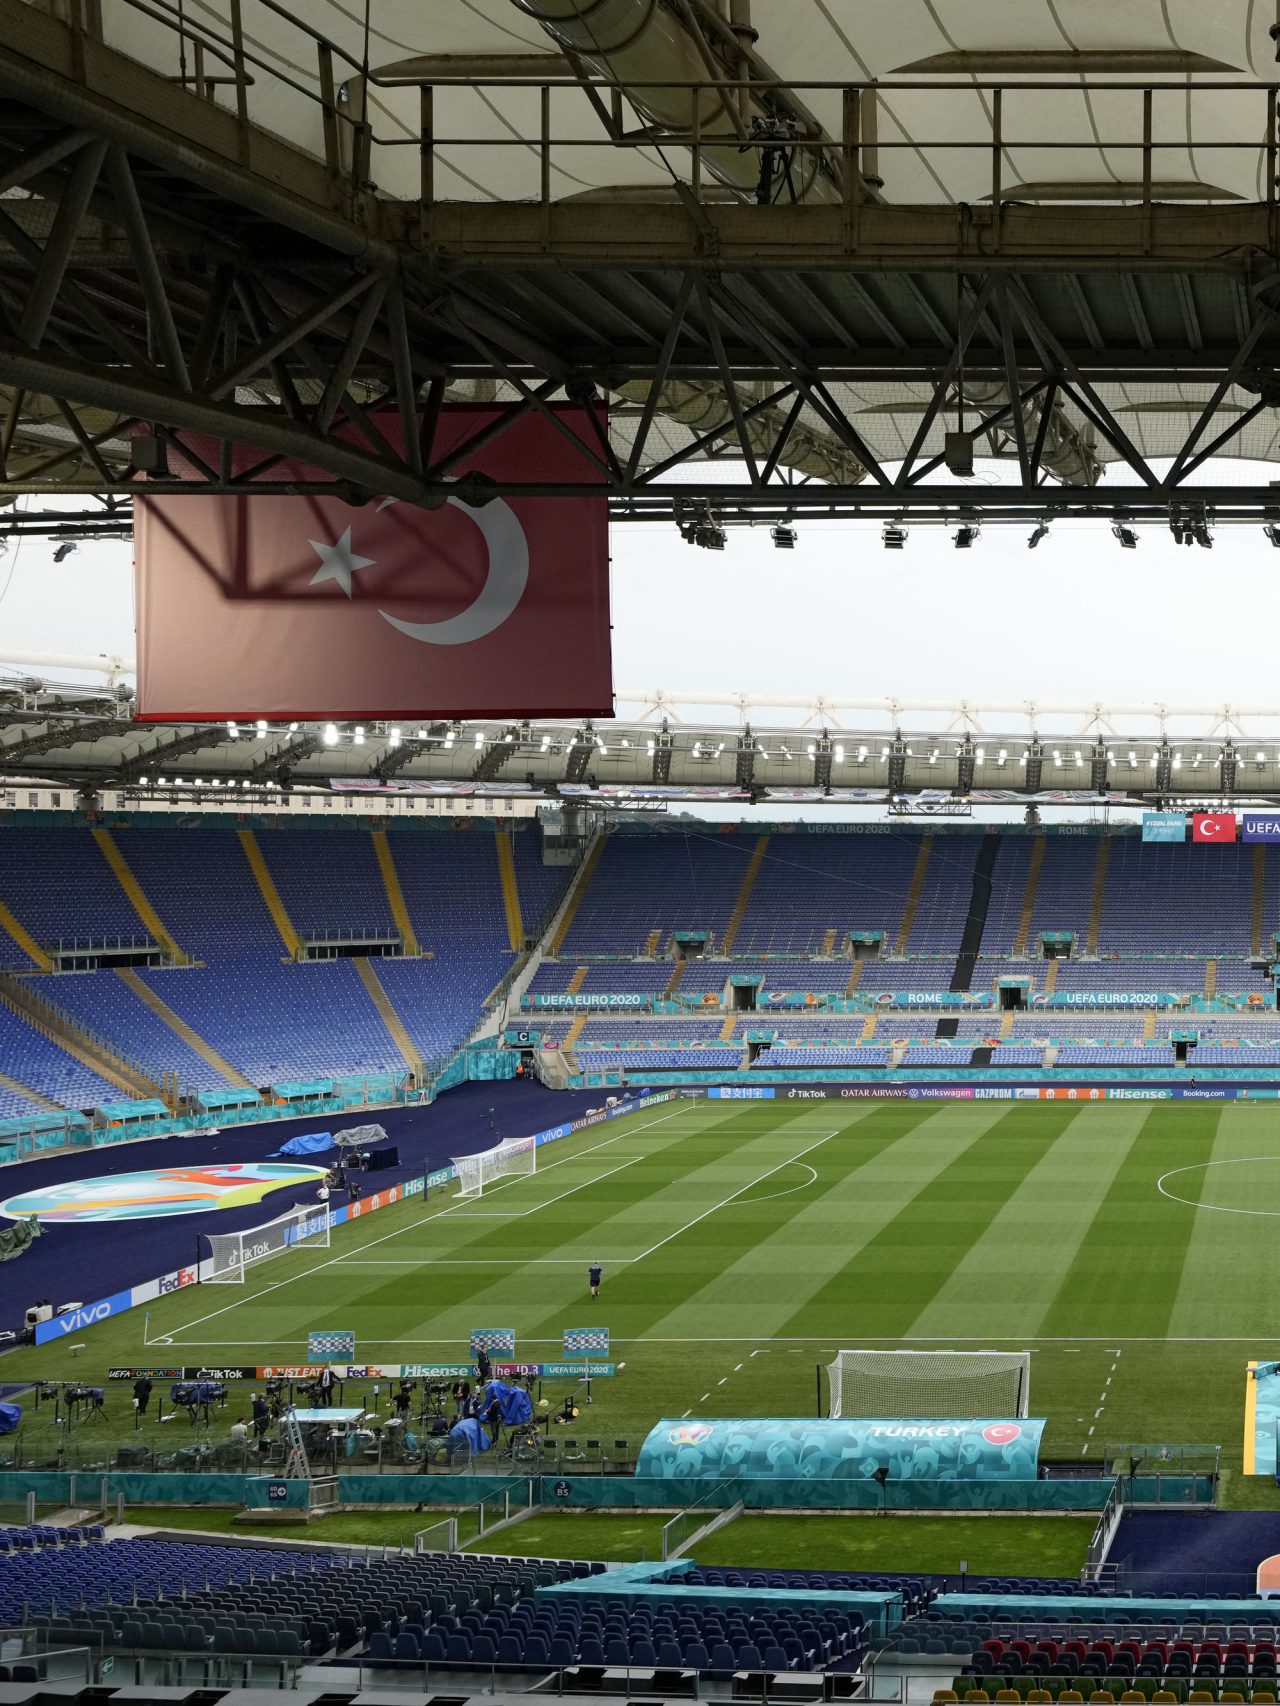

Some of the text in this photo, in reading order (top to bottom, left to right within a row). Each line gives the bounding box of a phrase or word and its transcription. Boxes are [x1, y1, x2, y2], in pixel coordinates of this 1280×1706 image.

[807, 825, 890, 834] UEFA EURO 2020
[1058, 826, 1088, 835] ROME
[541, 995, 640, 1005] UEFA EURO 2020
[908, 993, 942, 1003] ROME
[1066, 993, 1158, 1003] UEFA EURO 2020
[519, 1032, 528, 1041] C
[798, 1090, 826, 1098] TikTok
[841, 1089, 907, 1098] QATAR AIRWAYS
[921, 1088, 971, 1098] Volkswagen
[975, 1089, 1012, 1098] GAZPROM
[1110, 1089, 1166, 1099] Hisense
[1183, 1090, 1225, 1099] Booking.com
[639, 1093, 669, 1108] Heineken
[541, 1129, 563, 1143] vivo
[158, 1269, 195, 1294] FedEx
[60, 1302, 111, 1332] vivo
[109, 1369, 182, 1378] UEFA FOUNDATION
[302, 1367, 322, 1377] EAT
[347, 1366, 382, 1377] FedEx
[404, 1365, 468, 1376] Hisense
[871, 1427, 969, 1437] TURKEY
[560, 1481, 566, 1489] 3
[557, 1488, 569, 1496] BS
